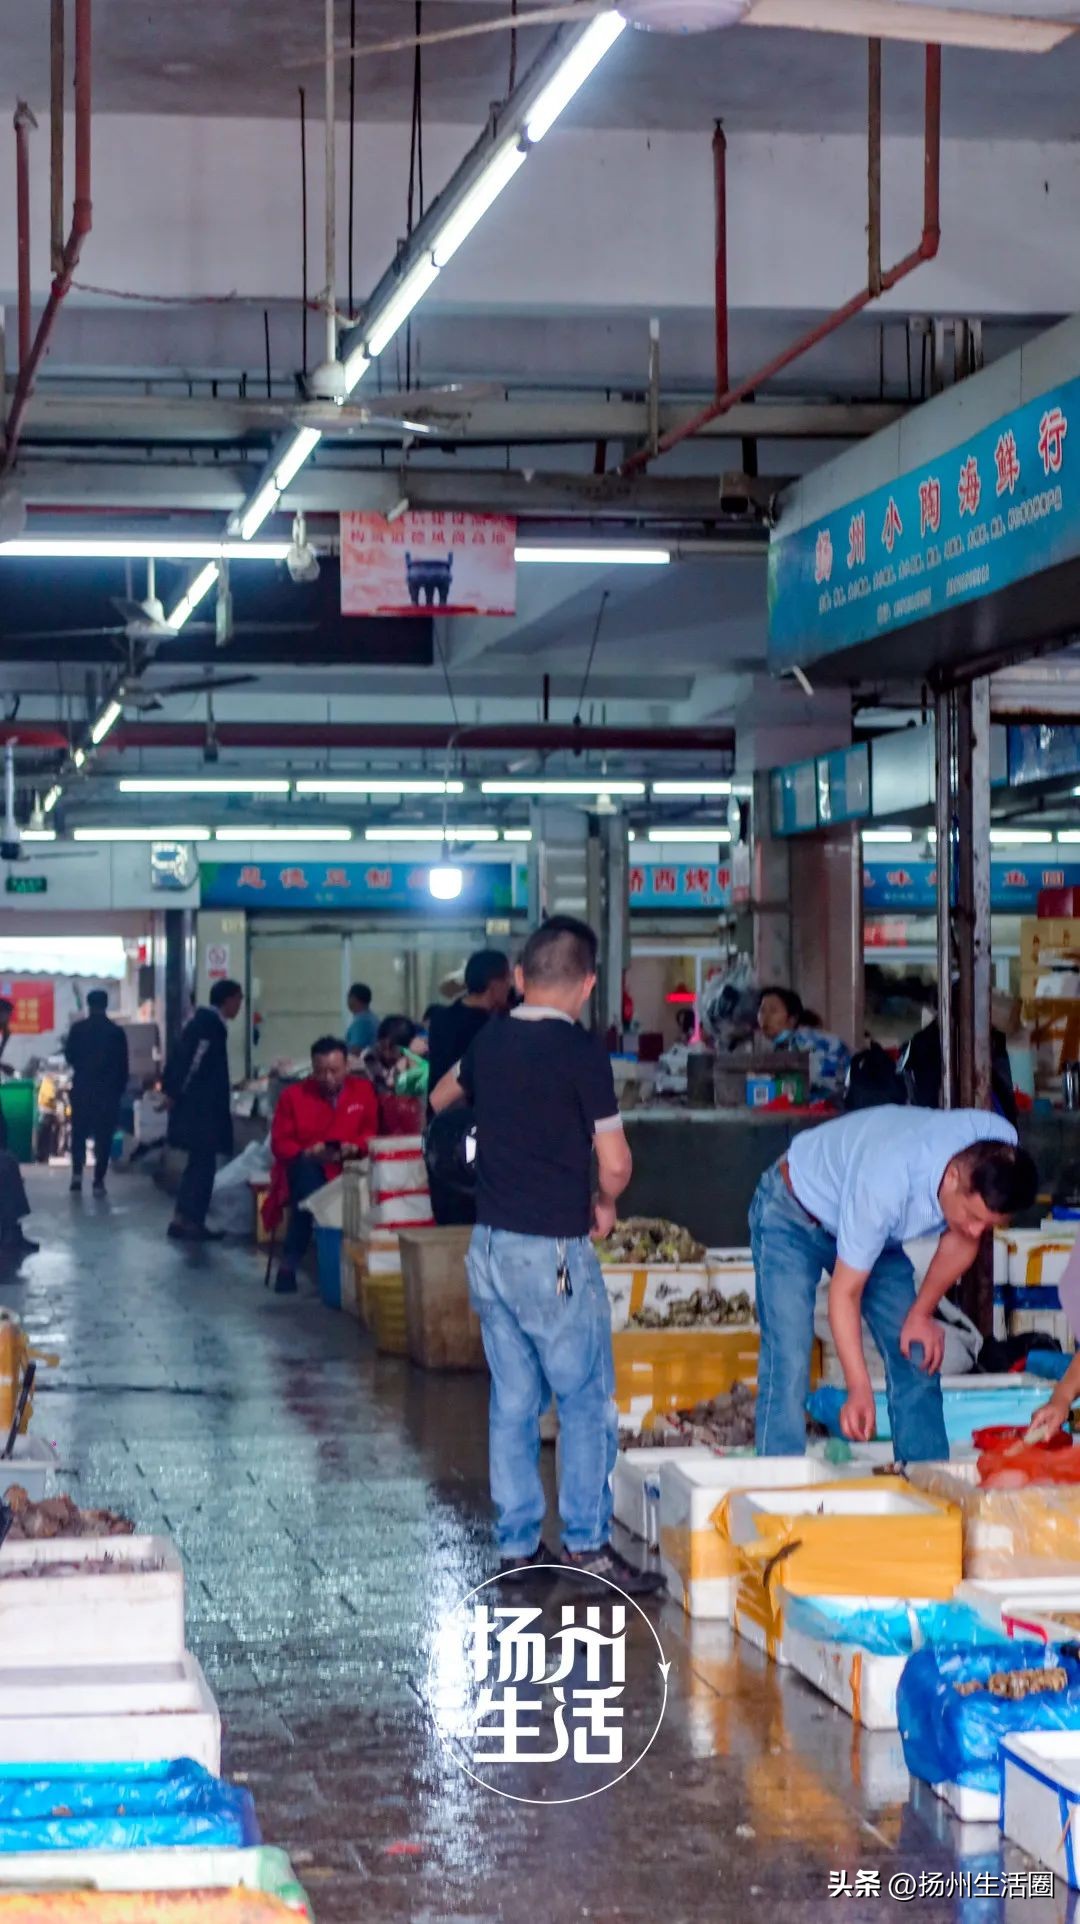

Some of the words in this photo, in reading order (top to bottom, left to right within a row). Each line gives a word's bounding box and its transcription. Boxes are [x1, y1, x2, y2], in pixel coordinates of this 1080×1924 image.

[815, 407, 1067, 583] 扬州小陶海鲜行
